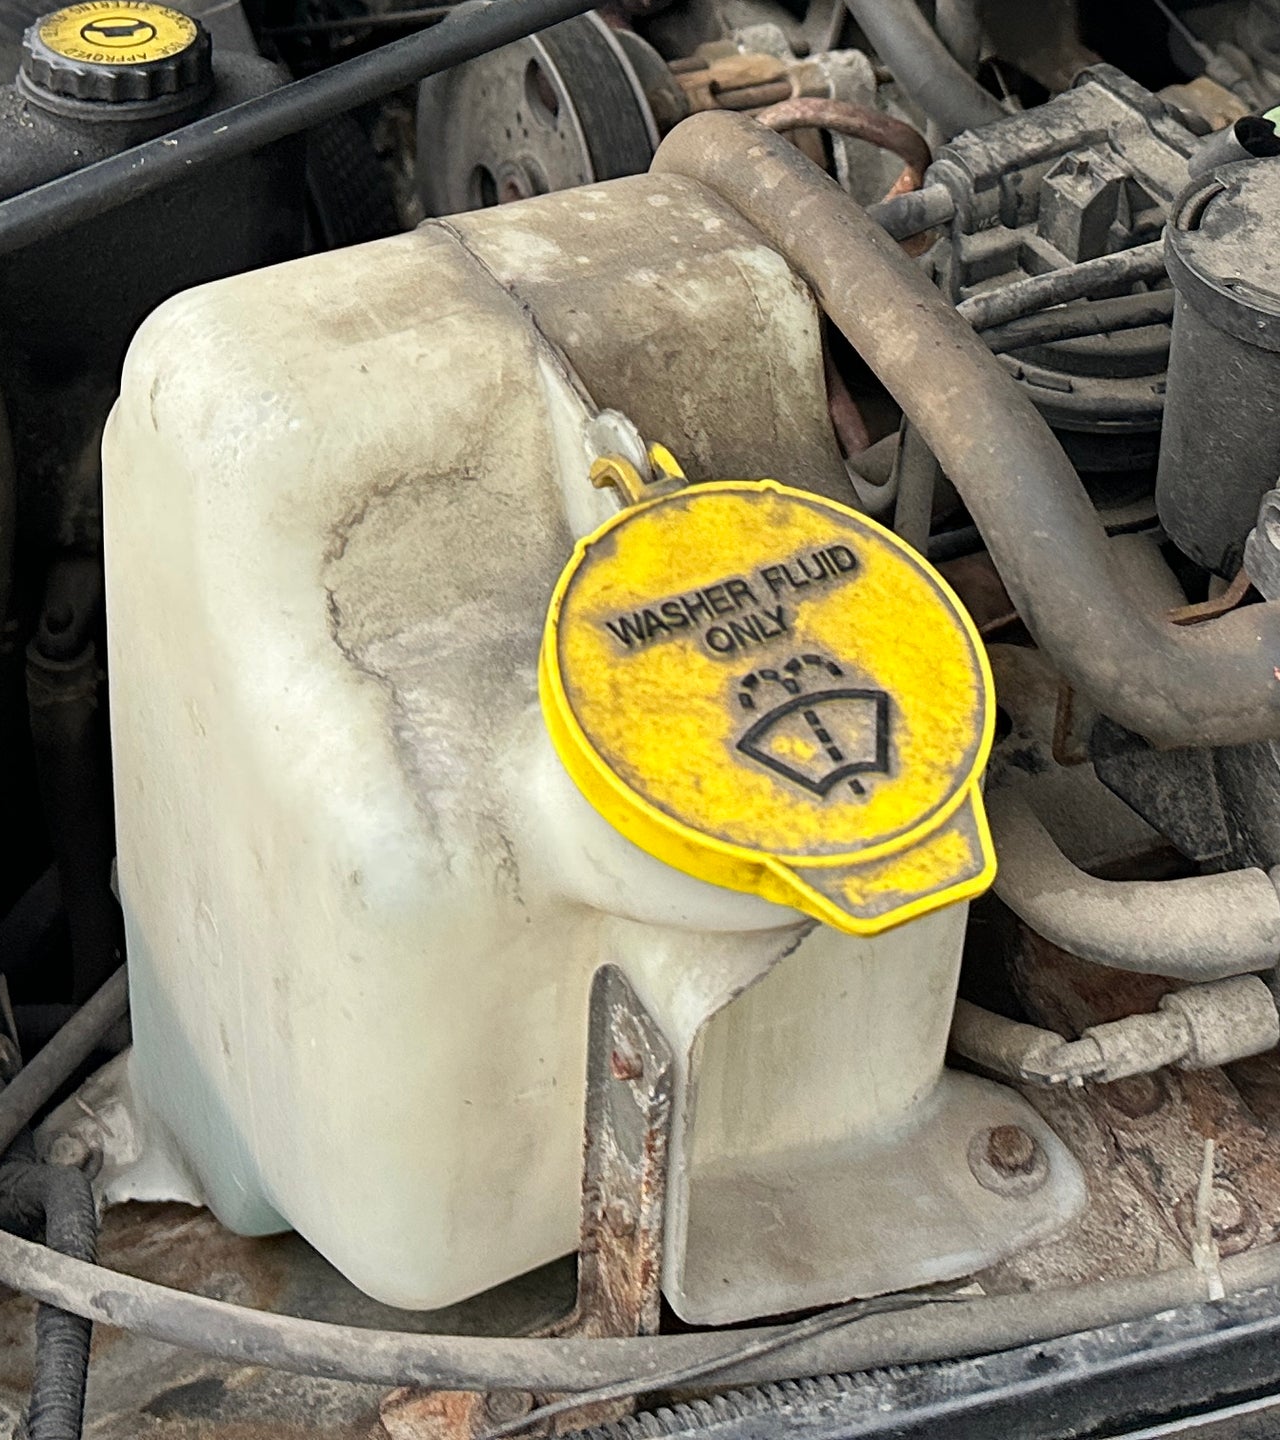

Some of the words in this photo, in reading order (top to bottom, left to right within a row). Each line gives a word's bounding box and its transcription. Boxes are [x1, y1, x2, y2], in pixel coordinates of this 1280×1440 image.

[63, 47, 148, 62] APPROVED
[607, 577, 758, 647] WASHER
[760, 543, 858, 591] FLUID
[705, 604, 790, 654] ONLY
